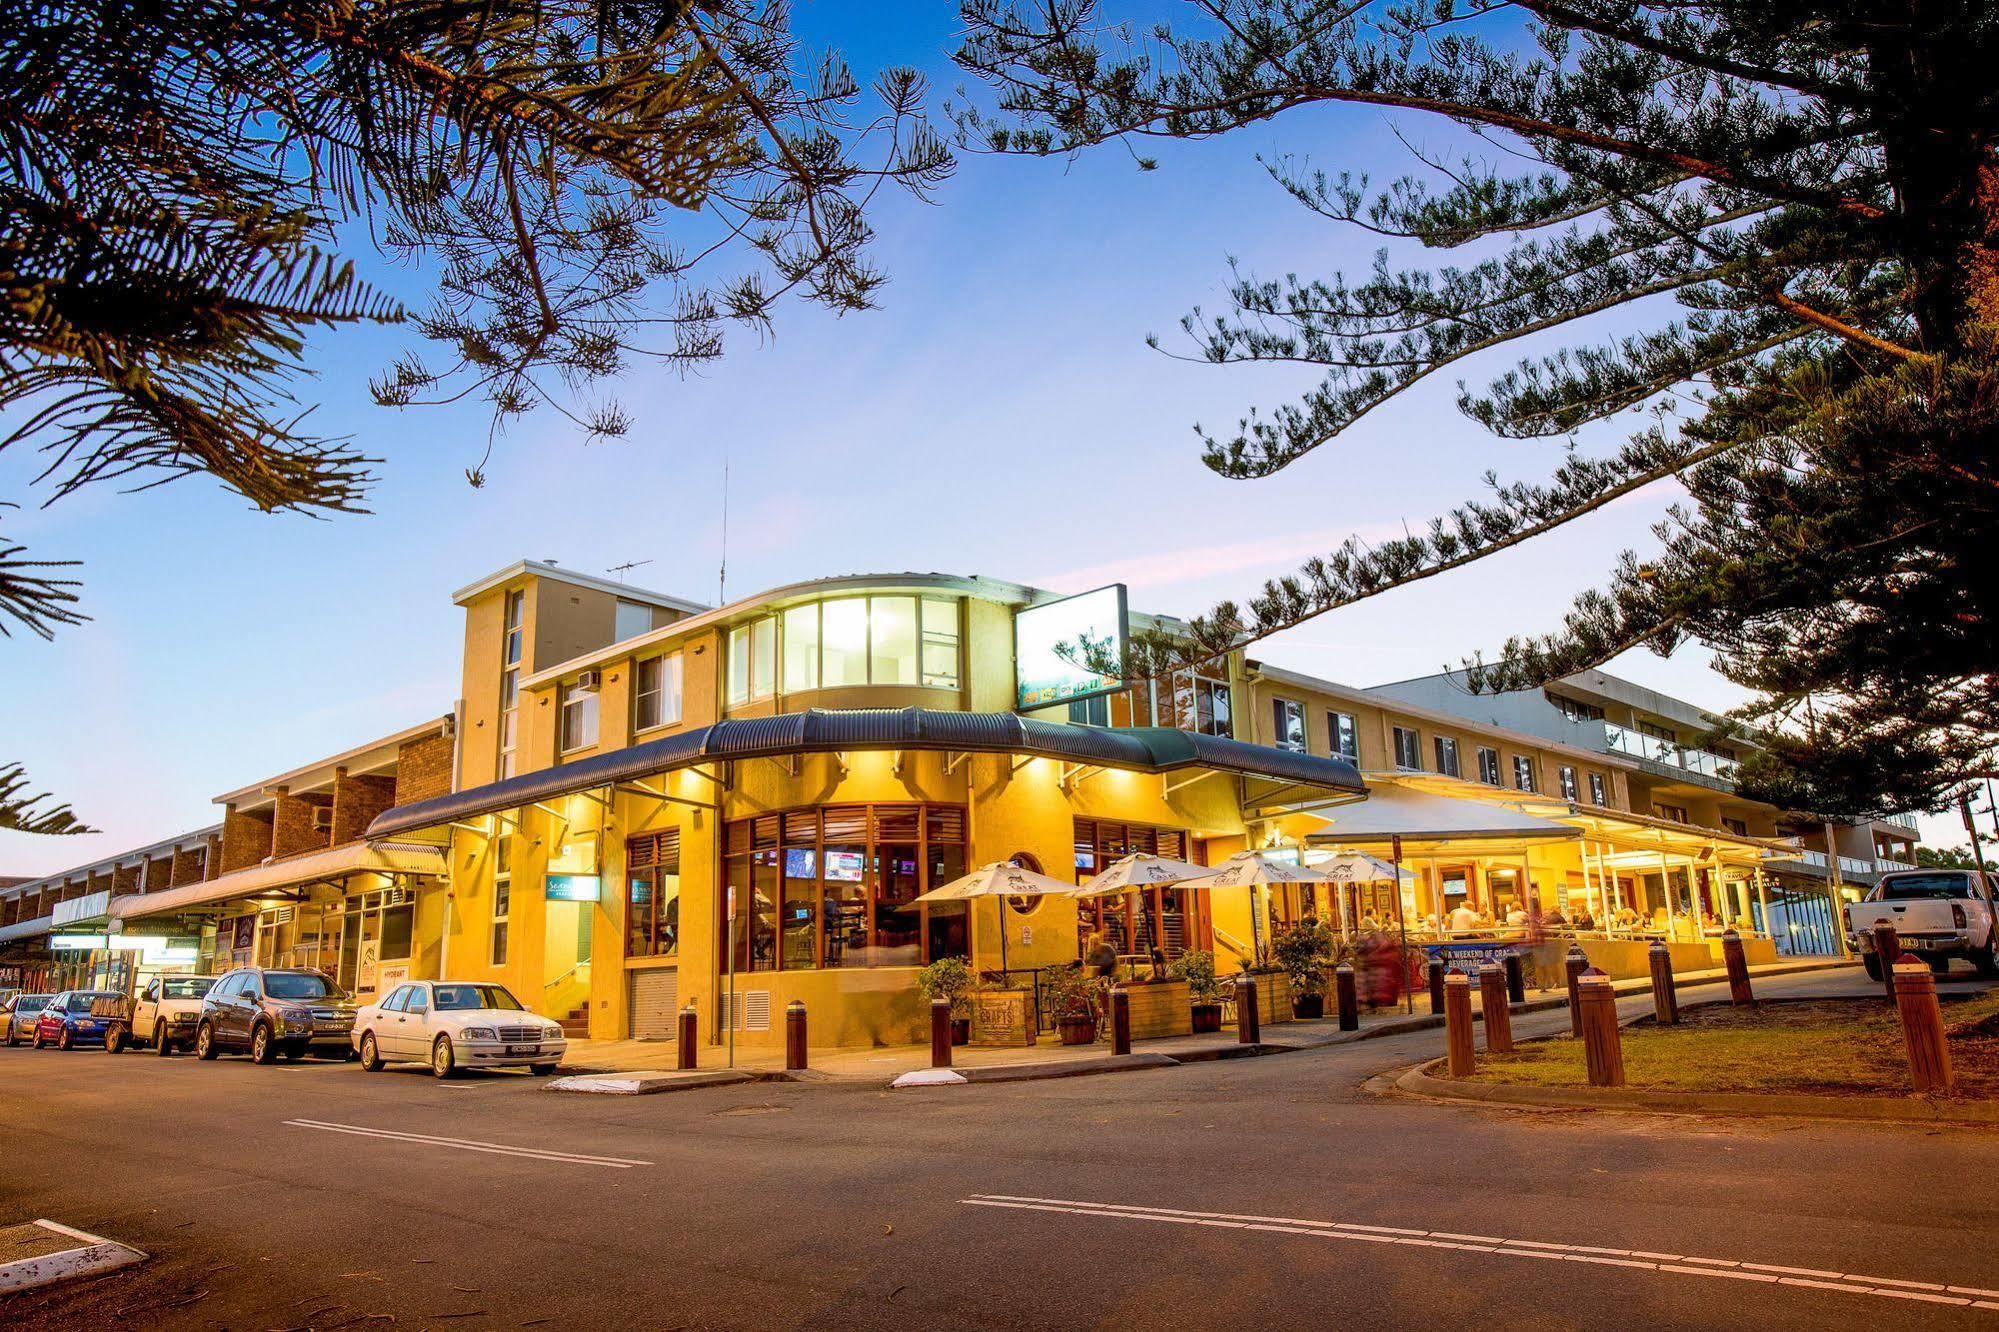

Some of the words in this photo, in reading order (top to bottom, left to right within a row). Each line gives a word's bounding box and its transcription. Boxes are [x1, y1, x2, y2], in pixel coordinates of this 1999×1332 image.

[1448, 951, 1453, 959] A
[1454, 950, 1484, 959] WEEKEND
[1485, 950, 1493, 958] OF
[384, 970, 406, 979] HYDRANT
[980, 1009, 1014, 1024] CRAFTS
